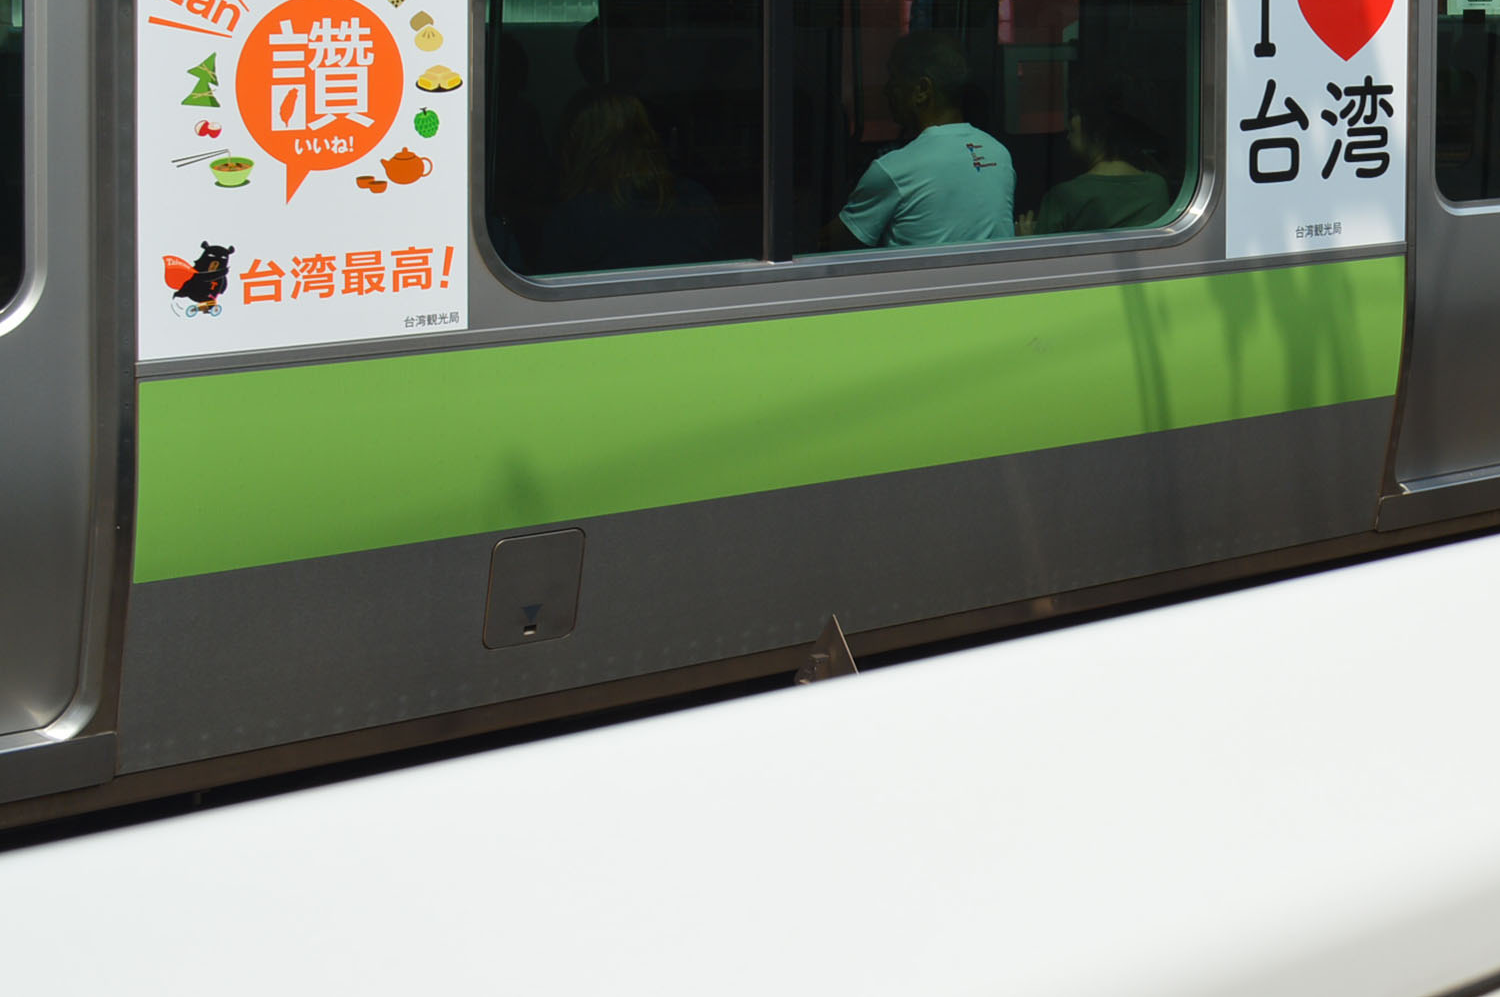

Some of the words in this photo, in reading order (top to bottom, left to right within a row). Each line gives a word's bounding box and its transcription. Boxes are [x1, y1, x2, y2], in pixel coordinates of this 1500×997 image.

[269, 17, 375, 131] 讚
[1240, 75, 1394, 184] 台湾
[1295, 221, 1342, 239] 台湾観光局
[239, 245, 454, 305] 台湾最高!
[404, 311, 460, 328] 台湾観光局
